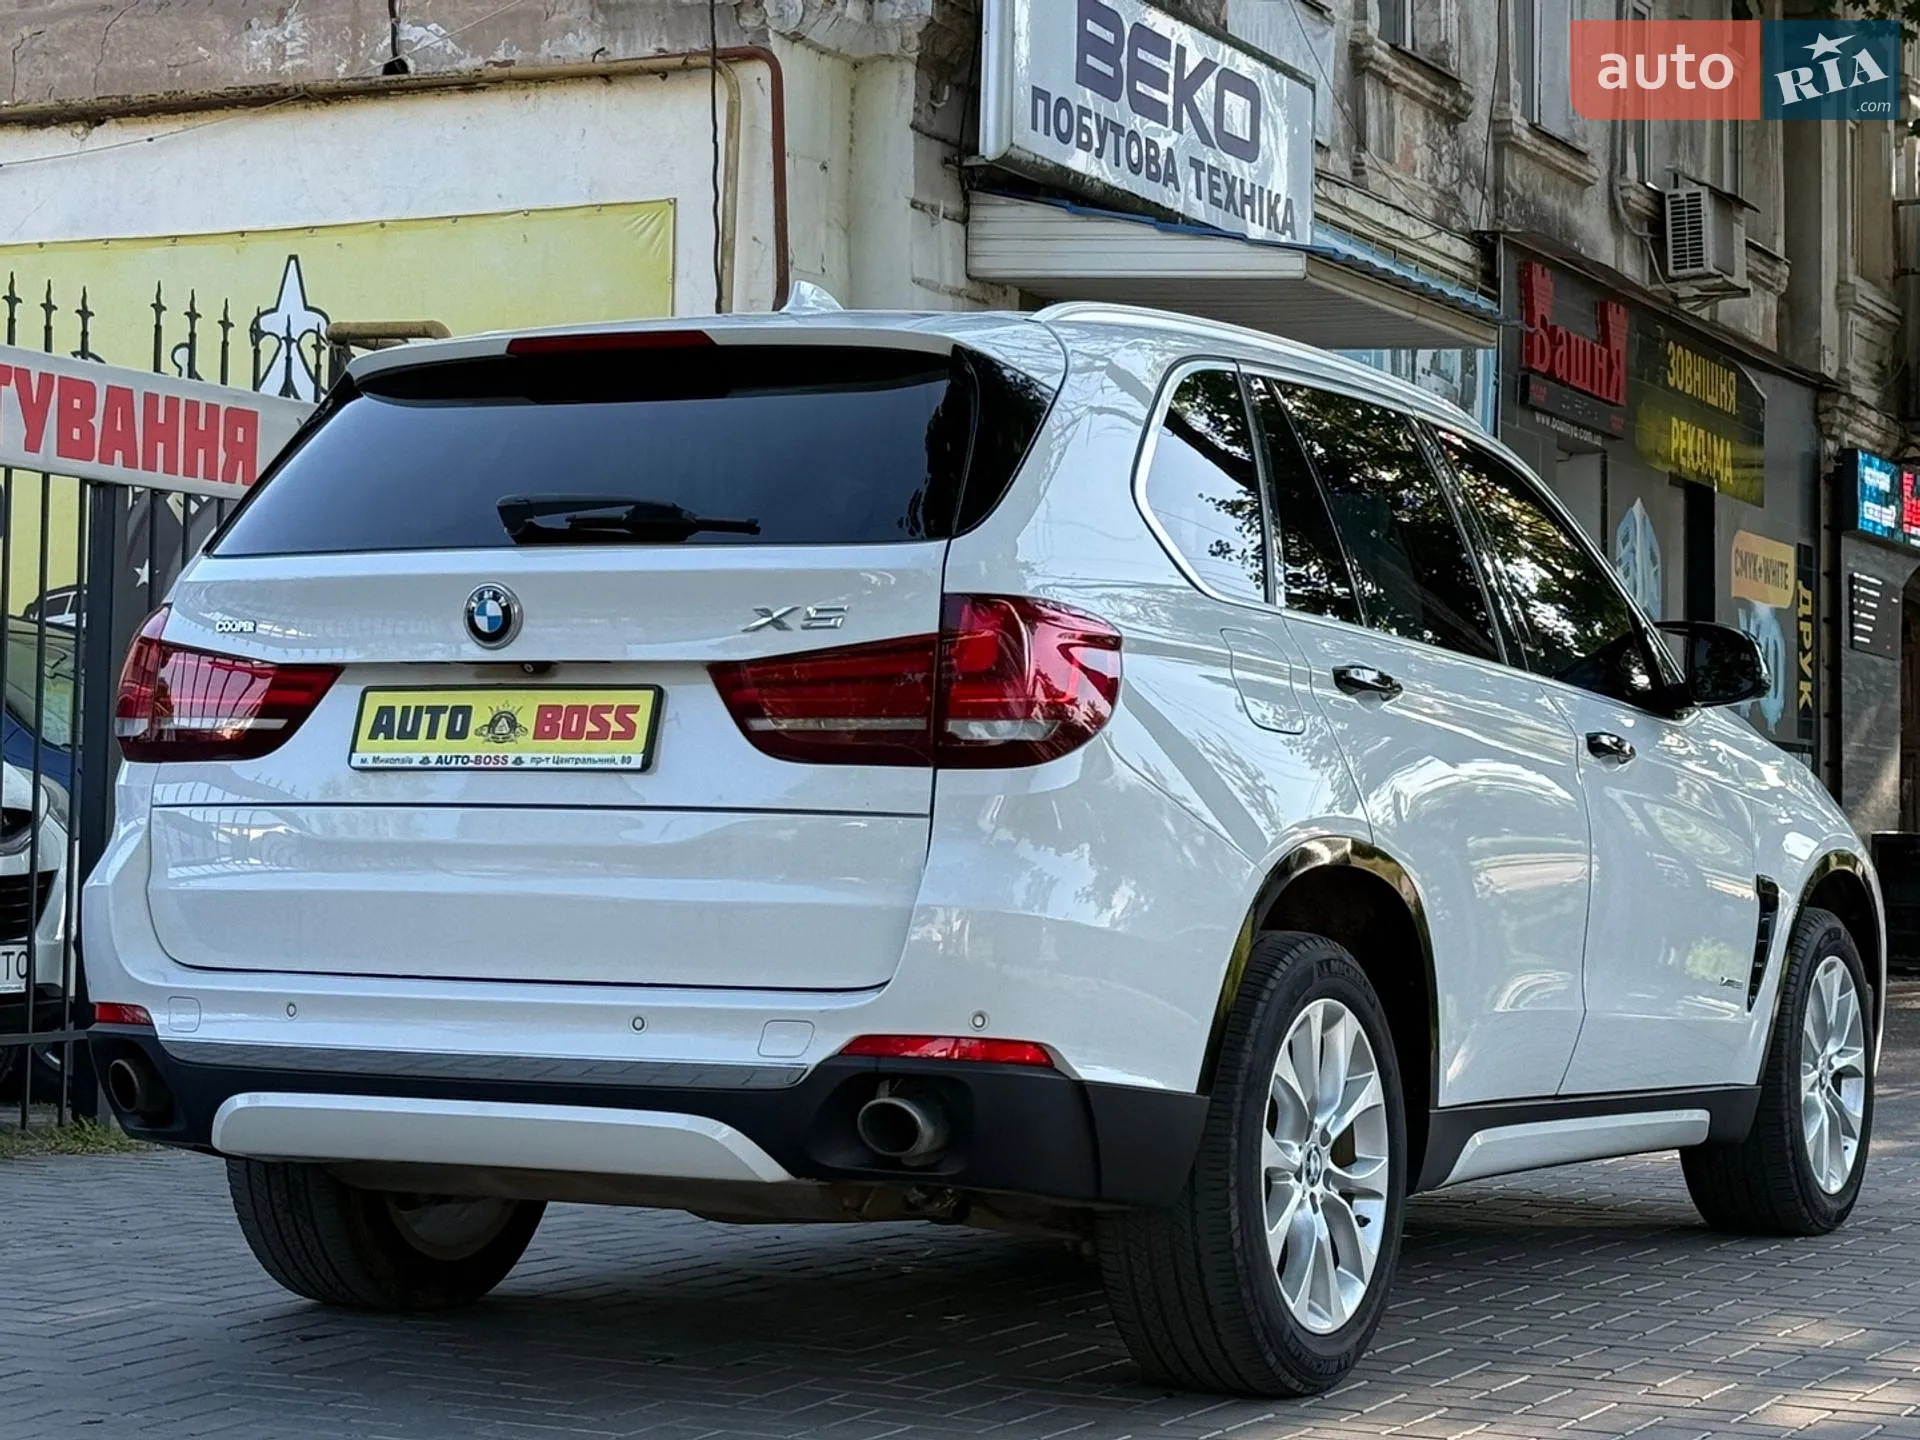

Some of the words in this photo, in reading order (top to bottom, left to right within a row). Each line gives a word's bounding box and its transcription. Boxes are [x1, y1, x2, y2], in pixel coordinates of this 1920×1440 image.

[1076, 0, 1262, 164] BEKO
[1031, 85, 1181, 192] ПОБУТОВА
[1189, 156, 1297, 240] ТЕХНІКА
[1667, 341, 1738, 415] ЗОВНІШНЯ
[1671, 416, 1733, 484] РЕКЛАМА
[1735, 548, 1789, 591] CMYK+WHITE
[215, 620, 256, 633] COOPER
[741, 605, 848, 632] X5
[1797, 580, 1813, 711] ДРУК
[367, 705, 473, 741] AUTO
[532, 704, 641, 741] BOSS
[435, 755, 509, 766] AUTO-BOSS
